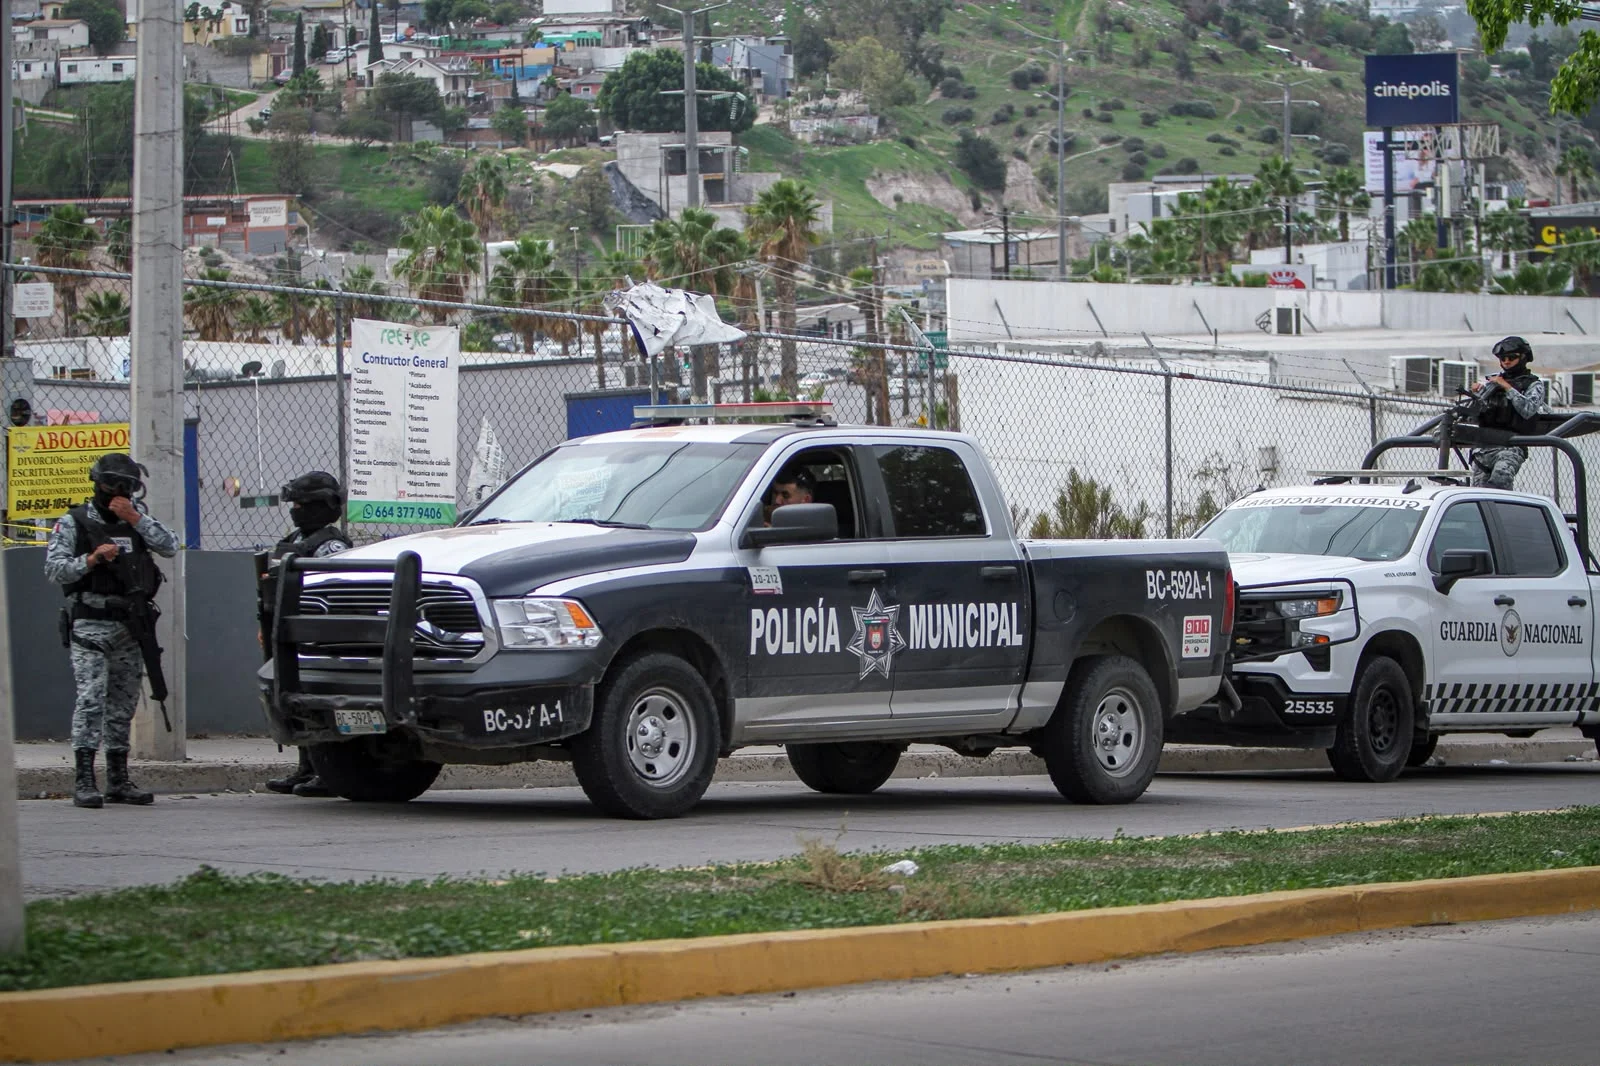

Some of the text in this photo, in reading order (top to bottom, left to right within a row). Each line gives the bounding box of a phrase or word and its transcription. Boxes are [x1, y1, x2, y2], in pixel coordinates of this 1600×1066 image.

[1374, 81, 1450, 99] cinépolis
[363, 352, 448, 368] Contructor General
[356, 408, 392, 416] Remodelaciones
[35, 429, 130, 450] ABOGADO
[18, 456, 64, 466] DIVORCIOS
[12, 467, 64, 477] ESCRITURAS
[375, 506, 442, 519] 664 377 9406
[753, 574, 778, 584] 20-212
[1146, 570, 1212, 599] BC-592A-1
[750, 598, 1023, 655] POLICÍA MUNICIPAL
[1186, 622, 1208, 632] 911
[1440, 621, 1583, 644] GUARDIA NACIONAL
[1285, 700, 1334, 714] 25535
